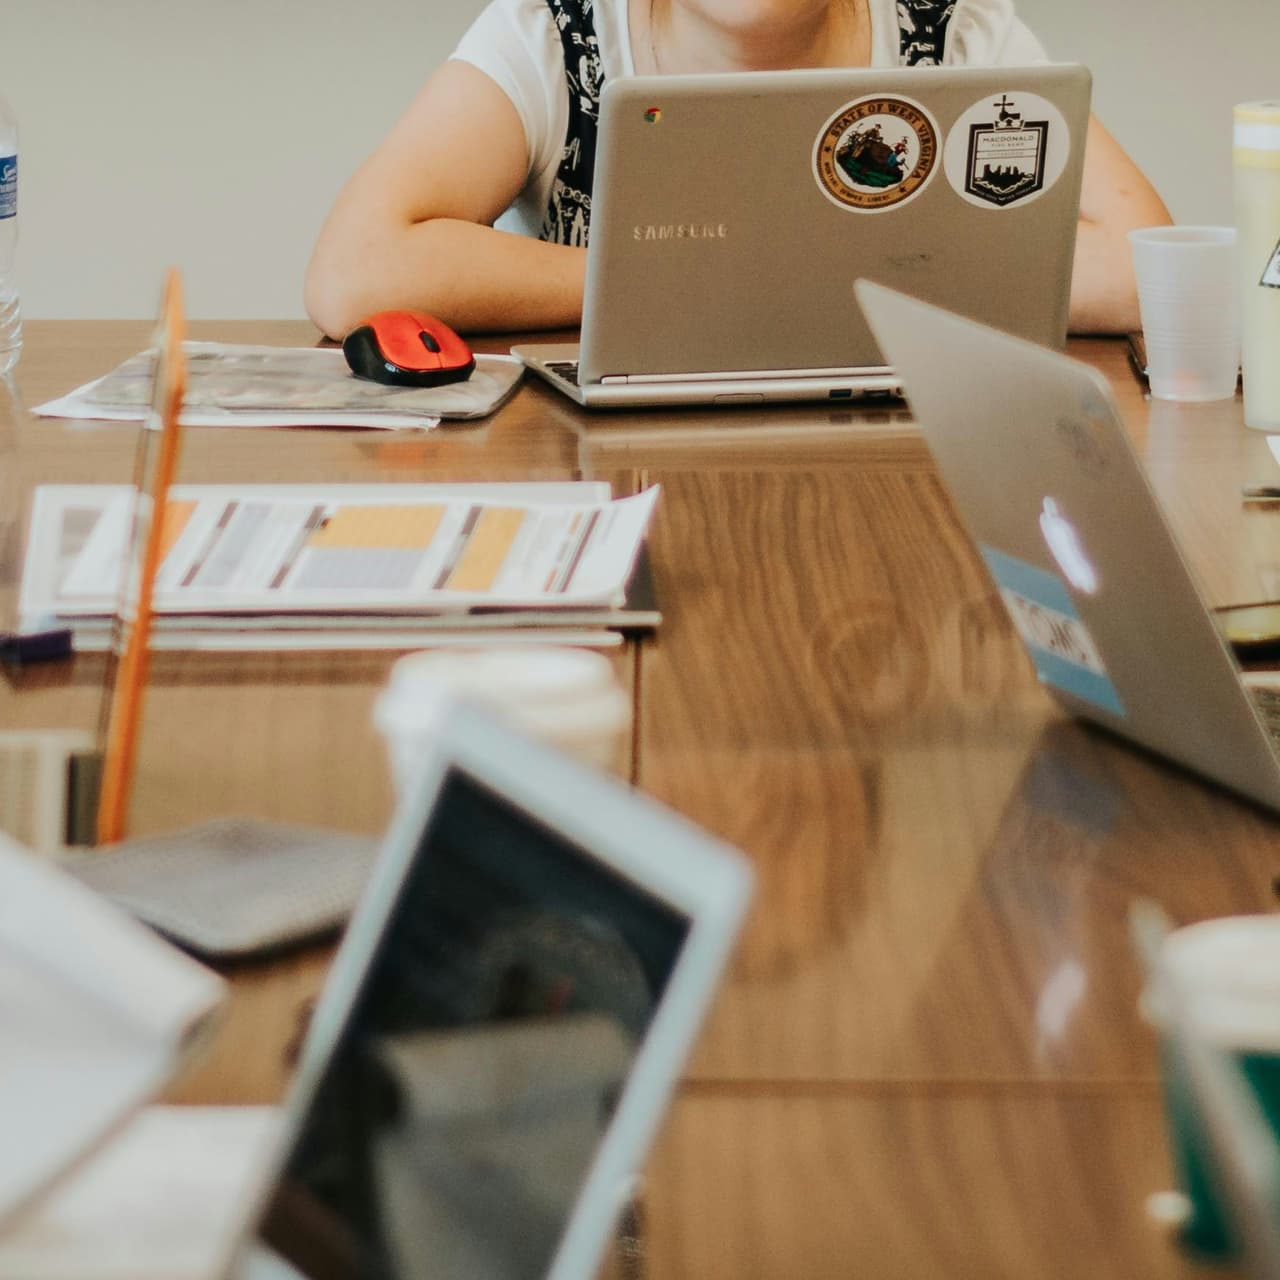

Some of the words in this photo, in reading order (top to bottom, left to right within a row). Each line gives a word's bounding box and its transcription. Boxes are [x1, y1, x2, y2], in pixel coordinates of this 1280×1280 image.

[831, 107, 865, 137] STATE
[868, 104, 884, 113] OF
[888, 104, 920, 125] WEST
[912, 122, 932, 179] VIRGINIA
[633, 224, 728, 240] SAMSUNG
